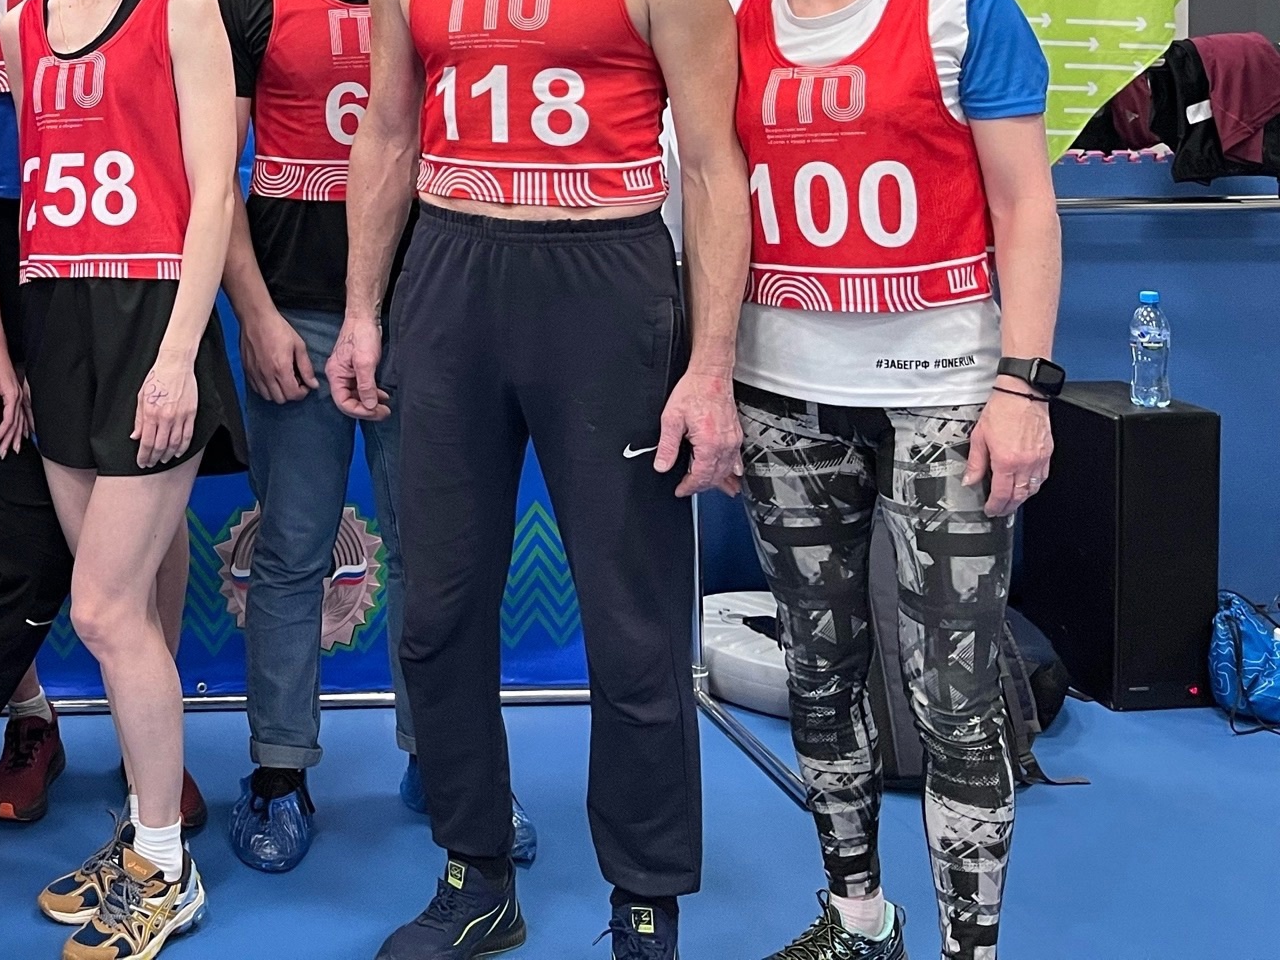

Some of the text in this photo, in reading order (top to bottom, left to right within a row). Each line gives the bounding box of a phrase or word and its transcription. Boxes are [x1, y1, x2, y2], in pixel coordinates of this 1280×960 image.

[328, 8, 371, 55] ГТ
[33, 51, 106, 113] ГТО
[435, 64, 590, 147] 118
[762, 65, 866, 125] ГТО
[325, 81, 369, 146] 6
[749, 160, 917, 248] 100
[876, 355, 976, 370] #ЗАБЕГРФ #ONERUN
